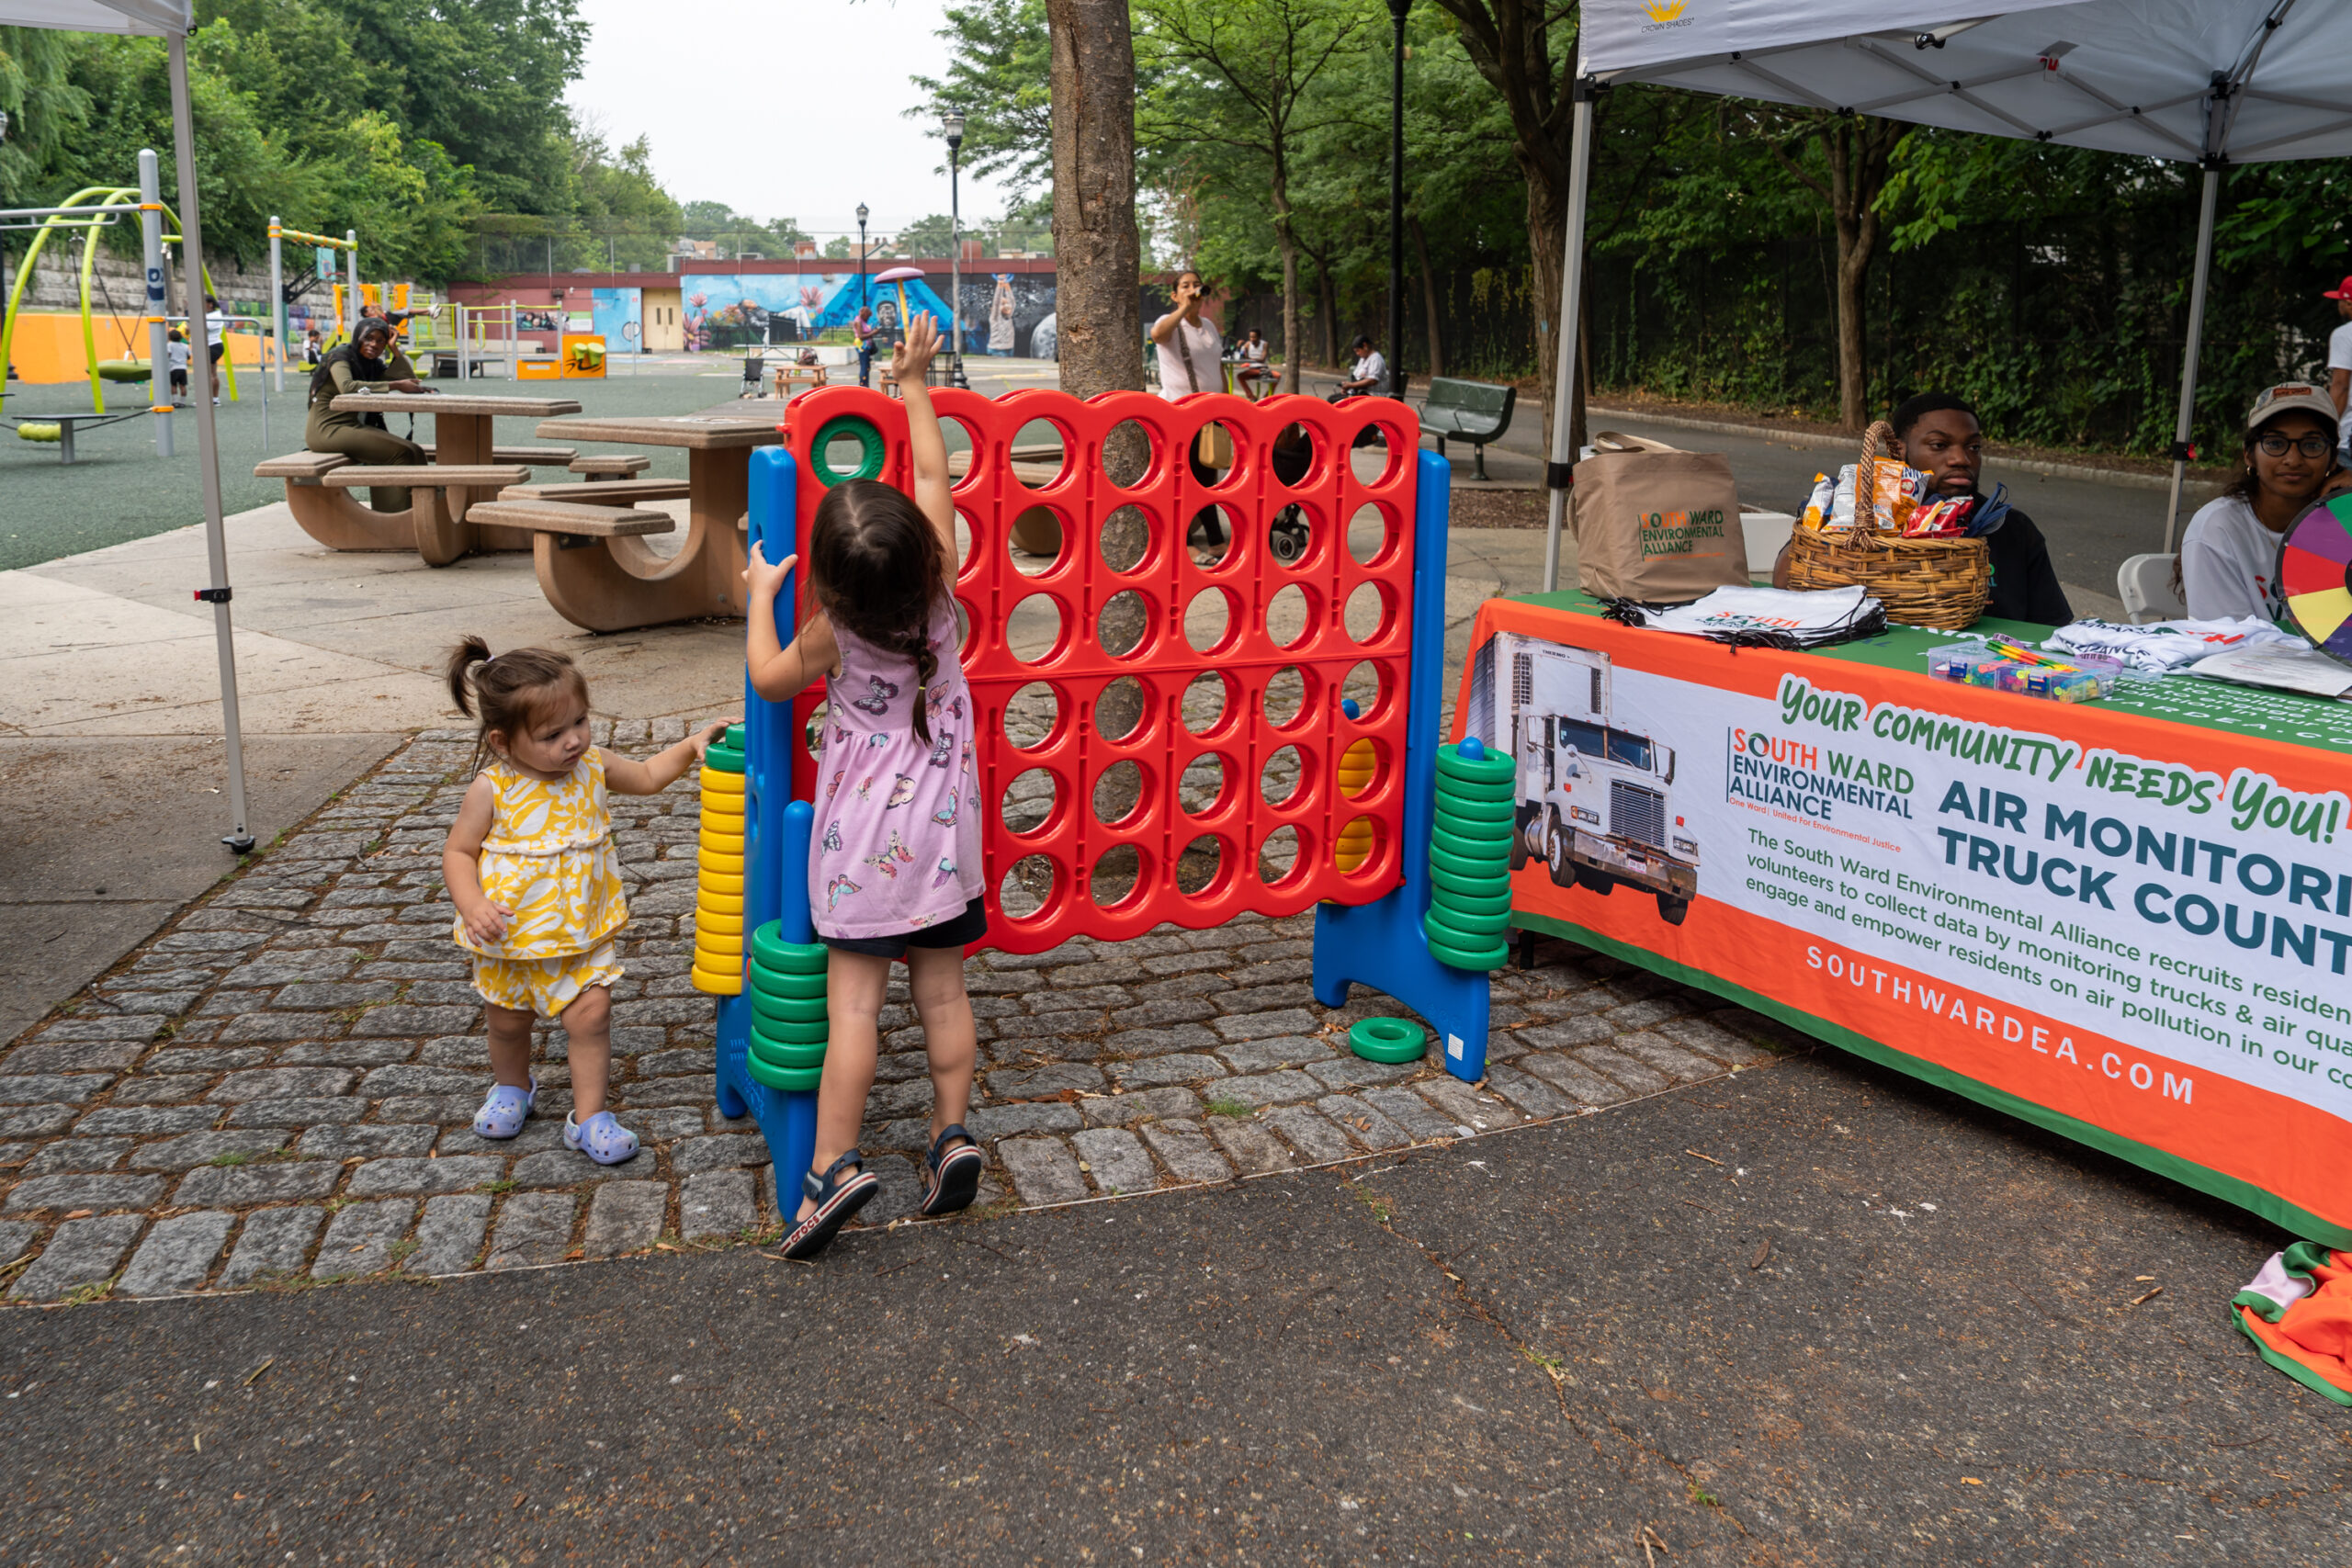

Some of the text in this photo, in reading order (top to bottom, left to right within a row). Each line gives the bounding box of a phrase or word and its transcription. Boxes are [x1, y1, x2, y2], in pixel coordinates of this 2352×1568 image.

[1641, 23, 1665, 34] CROWN
[1641, 510, 1724, 530] SOUTH WARD
[1642, 526, 1724, 542] ENVIRONMENTAL
[1644, 540, 1693, 556] ALLIANCE
[2160, 677, 2352, 716] Environmenta
[2199, 697, 2306, 718] engage
[2218, 694, 2313, 713] collect
[2230, 708, 2257, 716] in
[2266, 716, 2320, 727] our
[1733, 728, 1915, 795] SOUTH WARD
[1733, 754, 1913, 819] ENVIRONMENTAL
[1781, 680, 2340, 844] YOUR COMMUNITY NEEDS YOU!
[1729, 775, 1832, 820] ALLIANCE
[1729, 796, 1746, 808] One
[1772, 809, 1797, 823] United
[1799, 817, 1811, 827] For
[1813, 820, 1871, 844] Environmental
[1871, 838, 1902, 853] Justice
[1938, 780, 2352, 918] AIR MONITORI
[1747, 828, 2351, 1025] The South Ward Environmental Alliance recruits residen
[1938, 826, 2352, 976] TRUCK COUNT
[1746, 877, 1809, 907] engage
[1814, 897, 1846, 921] and
[1851, 912, 1941, 952] empower
[1948, 942, 2042, 986] residents
[2050, 978, 2077, 998] on
[2086, 988, 2115, 1009] air
[2121, 1000, 2231, 1048] pollution
[2241, 1033, 2263, 1058] in
[2273, 1049, 2319, 1075] our
[1747, 853, 2352, 1058] volunteers to collect data by monitoring trucks & air qua
[1805, 944, 2194, 1106] SOUTHWARDEA.COM
[791, 1215, 820, 1243] crocs
